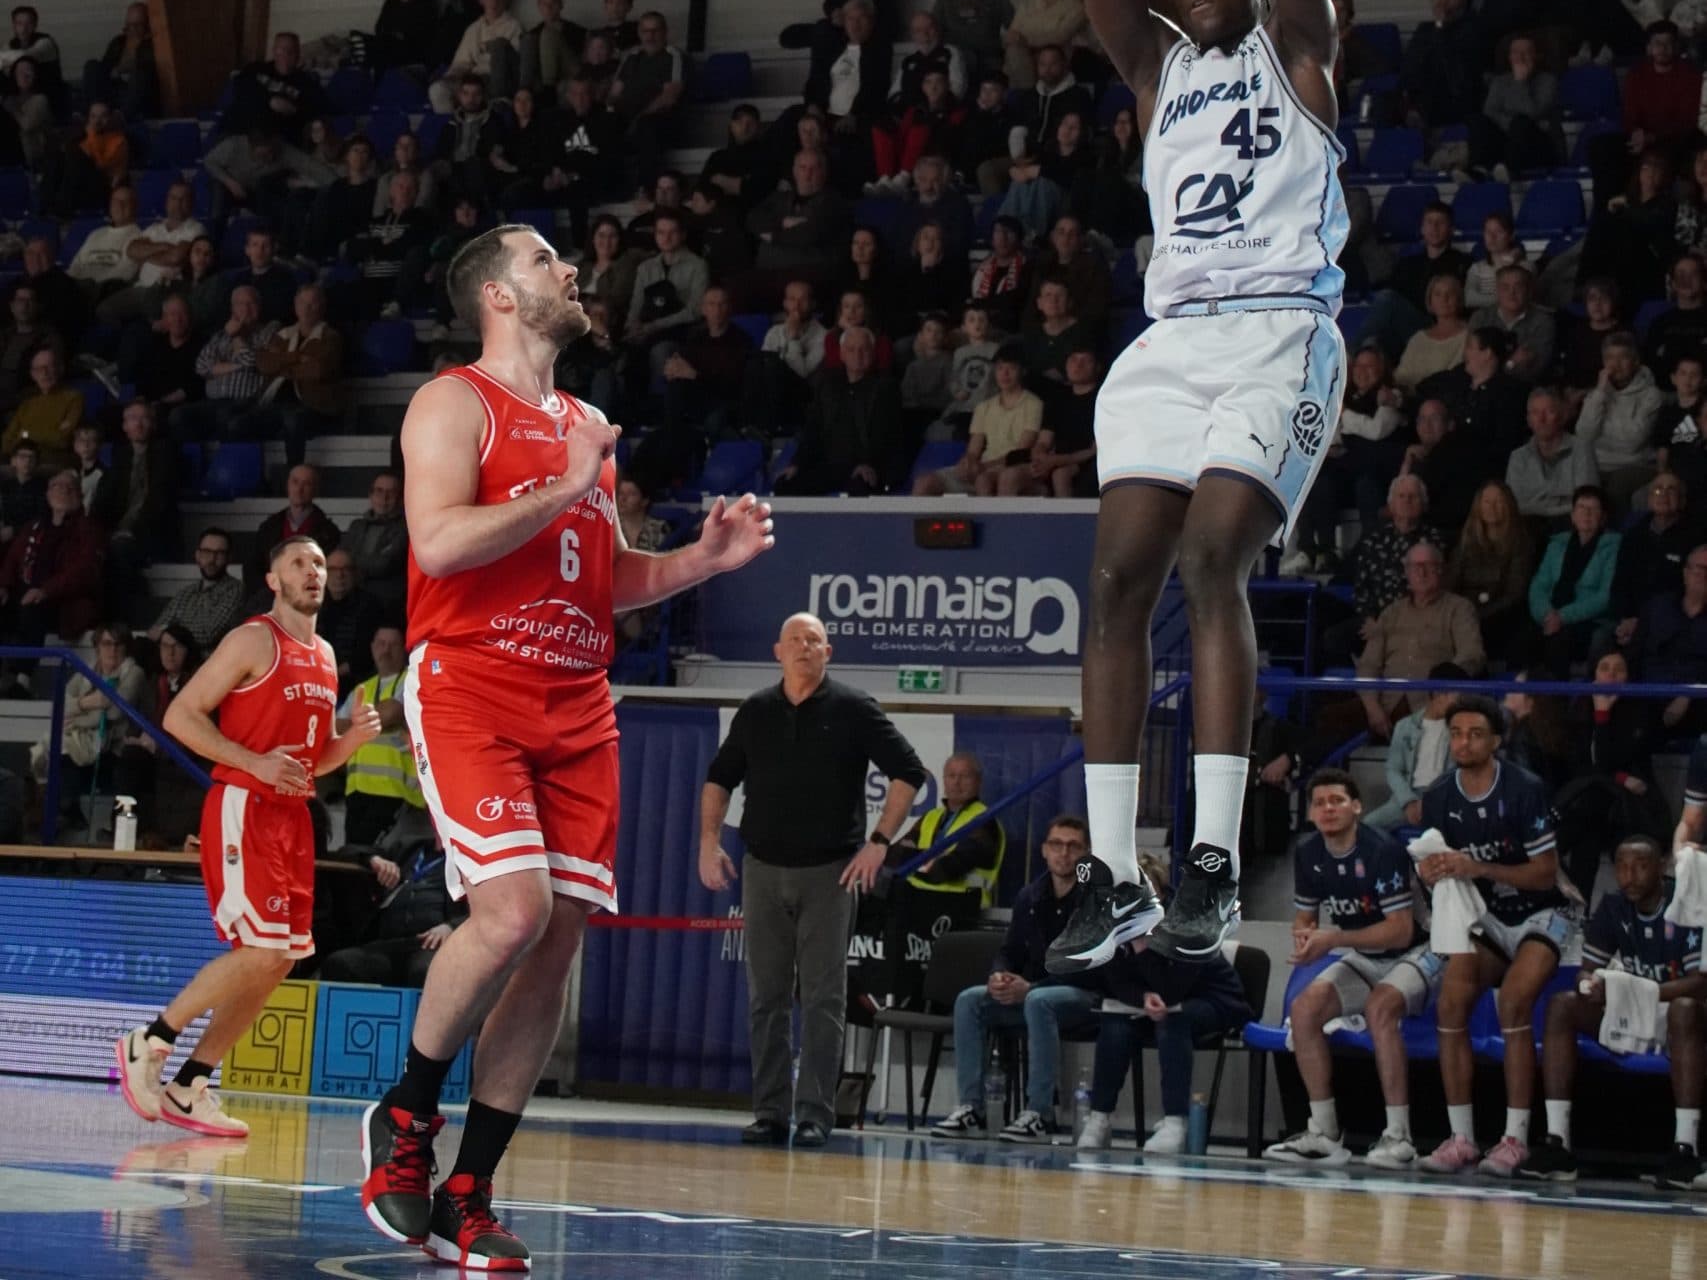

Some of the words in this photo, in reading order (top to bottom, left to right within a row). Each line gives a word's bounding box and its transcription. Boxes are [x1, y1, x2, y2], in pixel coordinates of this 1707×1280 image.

[1220, 106, 1282, 160] 45
[560, 528, 580, 583] 6
[810, 574, 1012, 621] roannais
[490, 613, 567, 641] Groupe
[568, 624, 609, 654] FAHY
[827, 621, 1010, 639] GGLOMERATION
[519, 645, 544, 660] ST
[283, 683, 303, 701] ST
[306, 714, 318, 748] 8
[229, 1072, 302, 1090] CHIRAT
